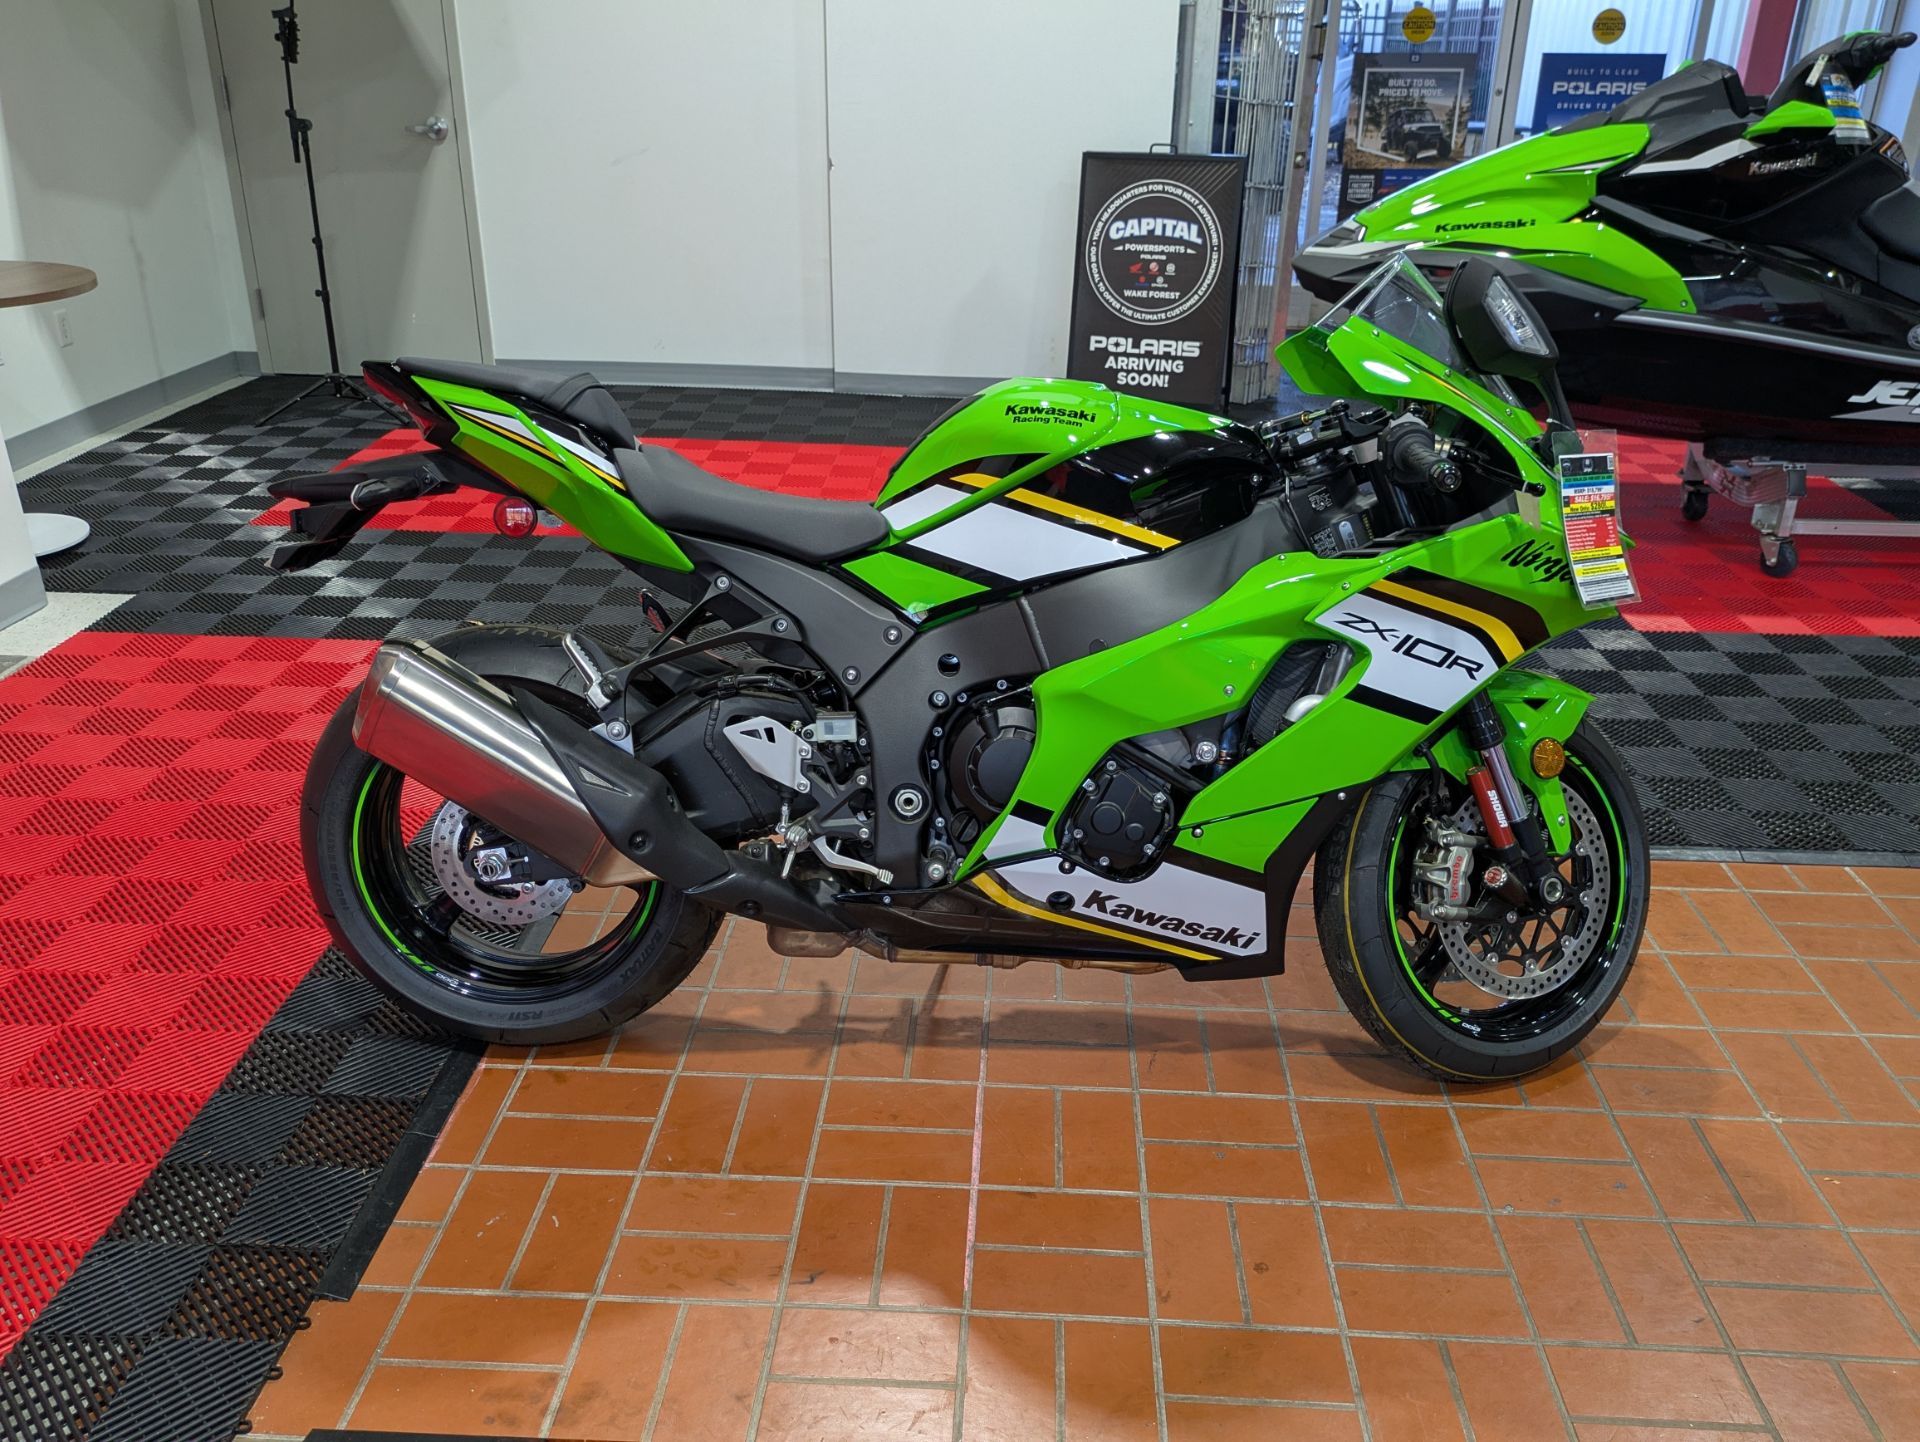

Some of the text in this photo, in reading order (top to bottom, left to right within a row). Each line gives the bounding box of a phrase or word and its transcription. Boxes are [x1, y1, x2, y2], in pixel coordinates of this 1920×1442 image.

[1567, 68, 1639, 76] BUILT TO LEAD
[1388, 78, 1411, 87] BUILT
[1413, 78, 1423, 87] TO
[1552, 81, 1647, 95] POLARIS
[1379, 88, 1408, 97] PRICED
[1409, 88, 1419, 97] TO
[1557, 102, 1592, 110] DRIVEN
[1596, 102, 1607, 110] TO
[1748, 152, 1818, 176] Kawasaki
[1092, 221, 1103, 240] YOUR
[1101, 185, 1148, 223] HEADQUARTERS
[1164, 185, 1183, 196] YOUR
[1183, 191, 1200, 206] NEXT
[1108, 217, 1203, 245] CAPITAL
[1434, 219, 1537, 233] Kawasaki
[1125, 243, 1185, 253] POWERSPORTS
[1091, 263, 1101, 283] GOAL
[1097, 282, 1106, 292] TO
[1103, 289, 1121, 310] OFFER
[1120, 306, 1133, 317] THE
[1133, 312, 1166, 321] ULTIMATE
[1166, 294, 1200, 318] CUSTOMER
[1123, 289, 1181, 300] WAKE FOREST
[1089, 335, 1201, 357] POLARIS
[1104, 356, 1184, 373] ARRIVING
[1117, 372, 1170, 387] SOON!
[1005, 404, 1097, 423] Kawasaki
[1013, 416, 1083, 427] Racing Team
[1333, 612, 1484, 681] ZX-10R
[1488, 790, 1508, 828] SHOWA
[1451, 855, 1462, 899] brembo
[1082, 889, 1261, 949] Kawasaki
